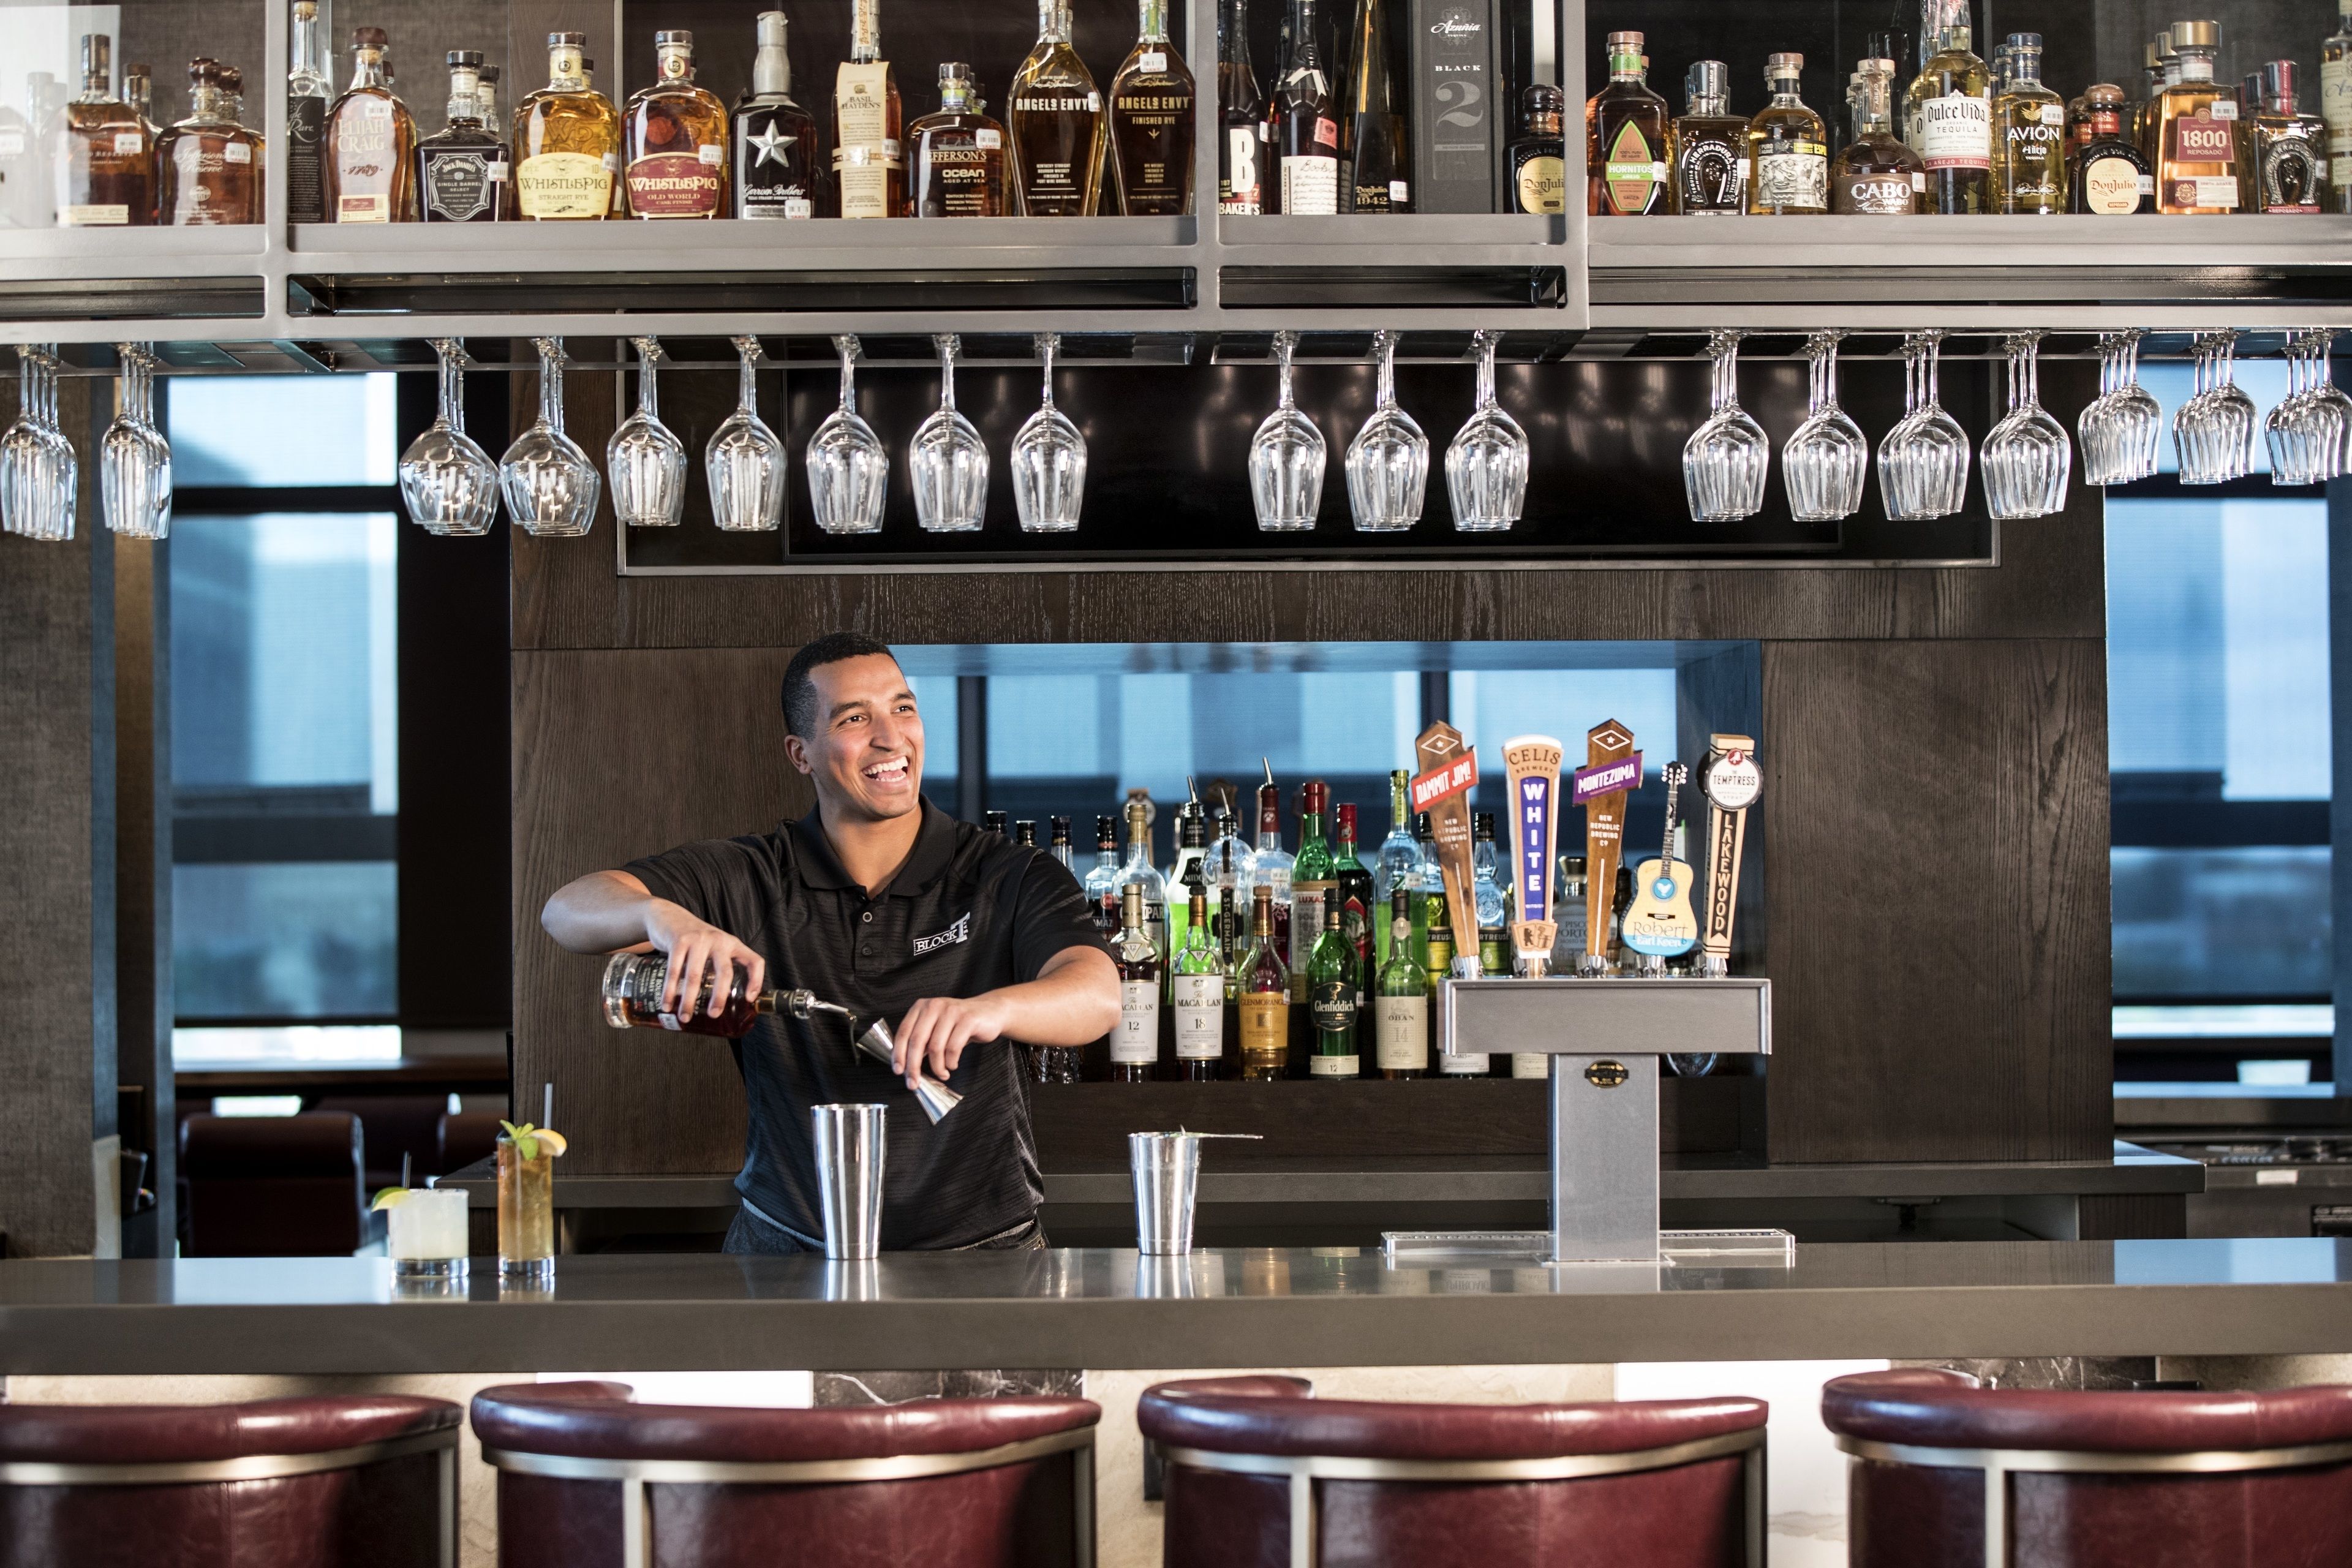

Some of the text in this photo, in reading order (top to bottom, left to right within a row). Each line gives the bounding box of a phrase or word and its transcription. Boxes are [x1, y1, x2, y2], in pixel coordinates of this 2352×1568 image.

[1060, 98, 1088, 111] ENVY
[1162, 96, 1189, 109] ENVY
[1436, 81, 1483, 127] 2
[1928, 102, 1986, 123] Dulce Vida
[337, 119, 385, 135] ELIJAH
[2007, 124, 2060, 141] AVIÓN
[337, 134, 385, 153] CRAIG
[2182, 129, 2227, 148] 1800
[921, 149, 987, 164] JEFFERSON'S
[1230, 128, 1256, 193] B
[1689, 144, 1735, 164] HERRADURA
[1608, 165, 1653, 174] HORNITOS
[520, 177, 608, 190] WHISTLEPIG
[628, 176, 718, 192] WHISTLEPIG
[1850, 183, 1911, 199] CABO
[1356, 196, 1389, 205] 1942
[1219, 202, 1260, 216] BAKER'S
[1509, 747, 1561, 765] CELIS
[1515, 765, 1555, 774] BREWERY
[1415, 760, 1472, 805] DAMMIT JIM!
[1578, 763, 1635, 794] MONTEZUMA
[1713, 774, 1755, 786] TEMPTRESS
[1590, 822, 1620, 831] REPUBLIC
[1523, 783, 1545, 892] WHITE
[1591, 831, 1618, 839] BREWING
[1714, 813, 1733, 931] LAKEWOOD
[1632, 921, 1689, 944] Robert
[916, 929, 957, 952] BLOCK
[1636, 935, 1682, 947] Earl Keen
[1177, 998, 1221, 1007] MACALLAN
[1314, 1000, 1355, 1012] Glenfiddich
[1128, 1021, 1140, 1030] 12
[1195, 1018, 1206, 1030] 18
[1393, 1027, 1409, 1042] 14
